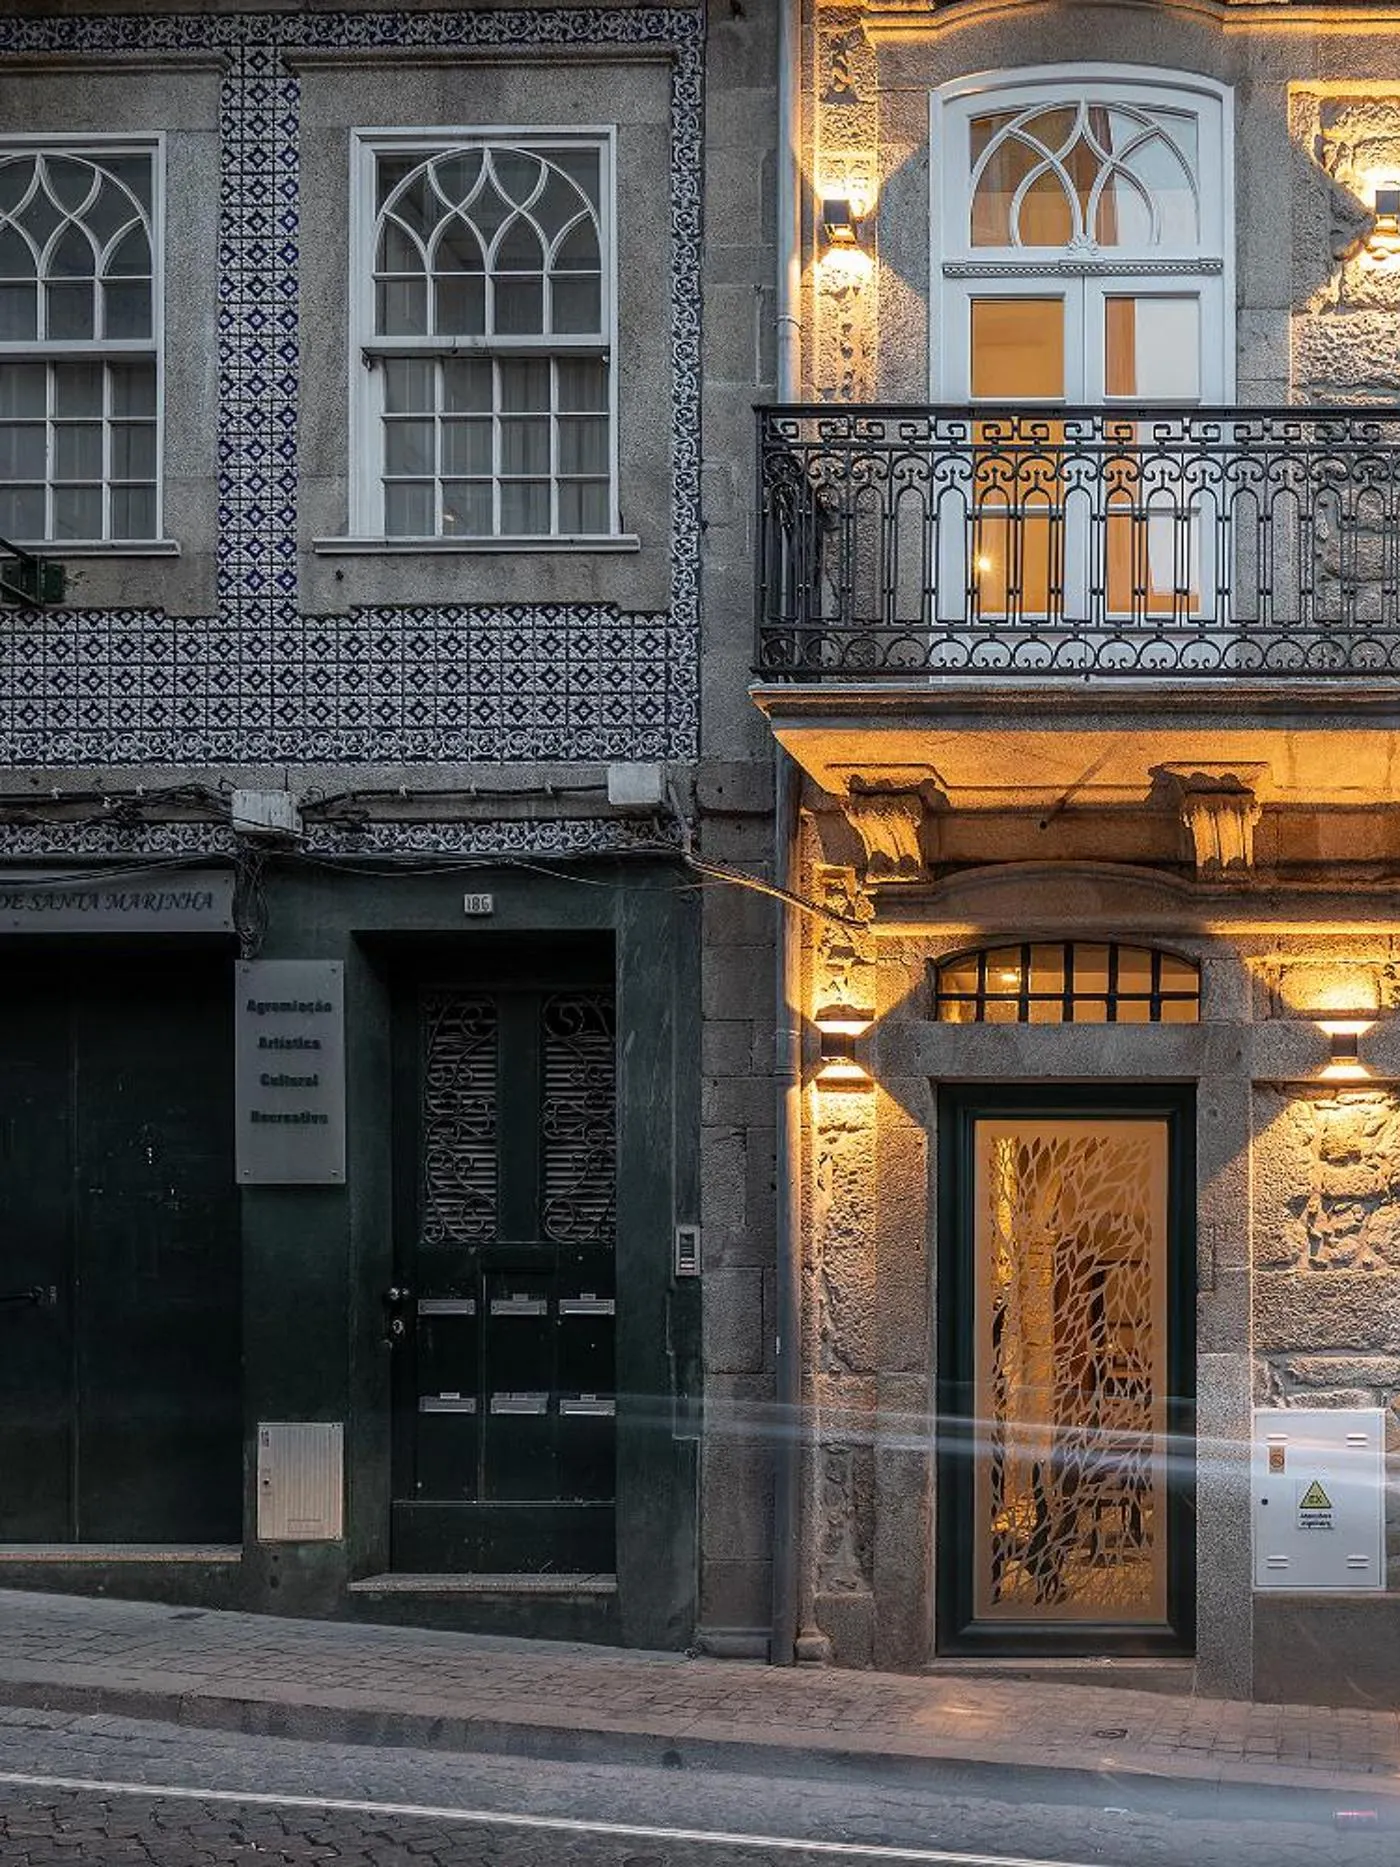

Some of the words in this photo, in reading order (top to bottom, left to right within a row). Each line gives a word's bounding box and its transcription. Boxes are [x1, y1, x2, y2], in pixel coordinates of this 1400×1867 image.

[28, 892, 99, 912] SANTA
[104, 891, 214, 912] MARINHA
[467, 895, 490, 911] 186
[260, 1073, 319, 1088] Cultural
